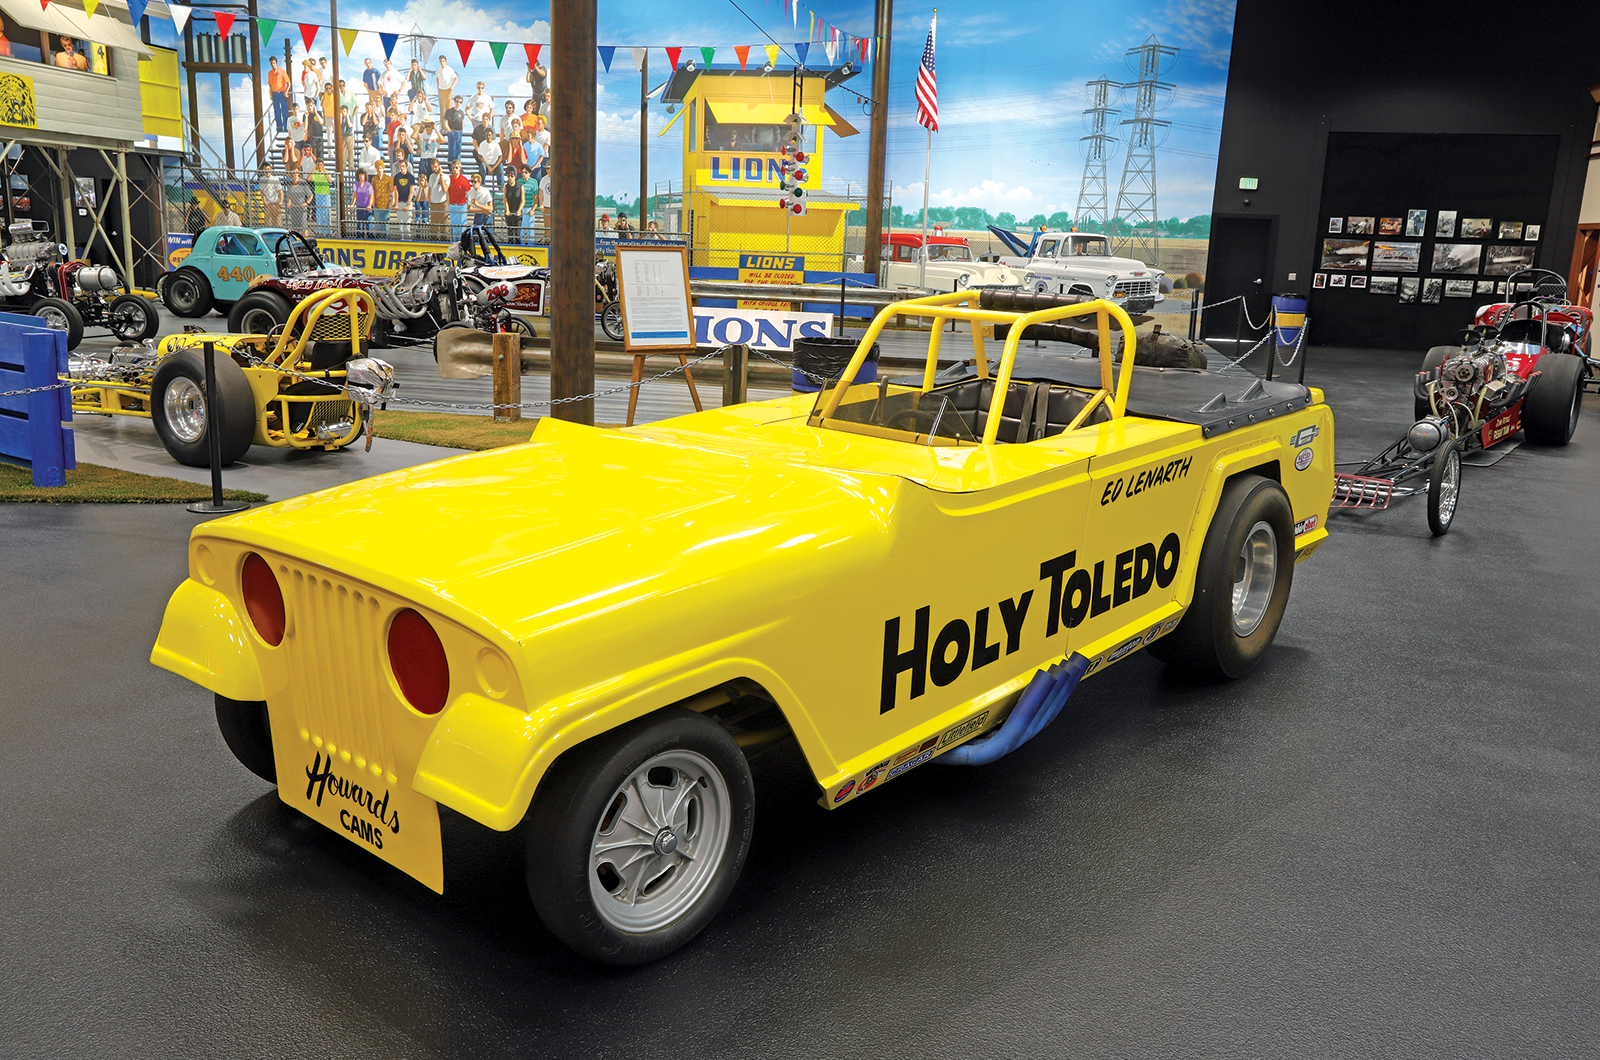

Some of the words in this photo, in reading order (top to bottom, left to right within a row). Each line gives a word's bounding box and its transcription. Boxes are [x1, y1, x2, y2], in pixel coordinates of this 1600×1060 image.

[168, 236, 181, 244] WIN
[317, 247, 366, 270] ONS
[746, 256, 796, 270] LIONS
[217, 266, 255, 283] 440
[486, 283, 509, 302] 298
[1100, 477, 1123, 507] ED
[1125, 455, 1193, 498] LENARTH
[879, 589, 1035, 716] HOLY
[1039, 532, 1181, 639] TOLEDO
[306, 751, 400, 834] Howards
[340, 809, 383, 849] CAMS
